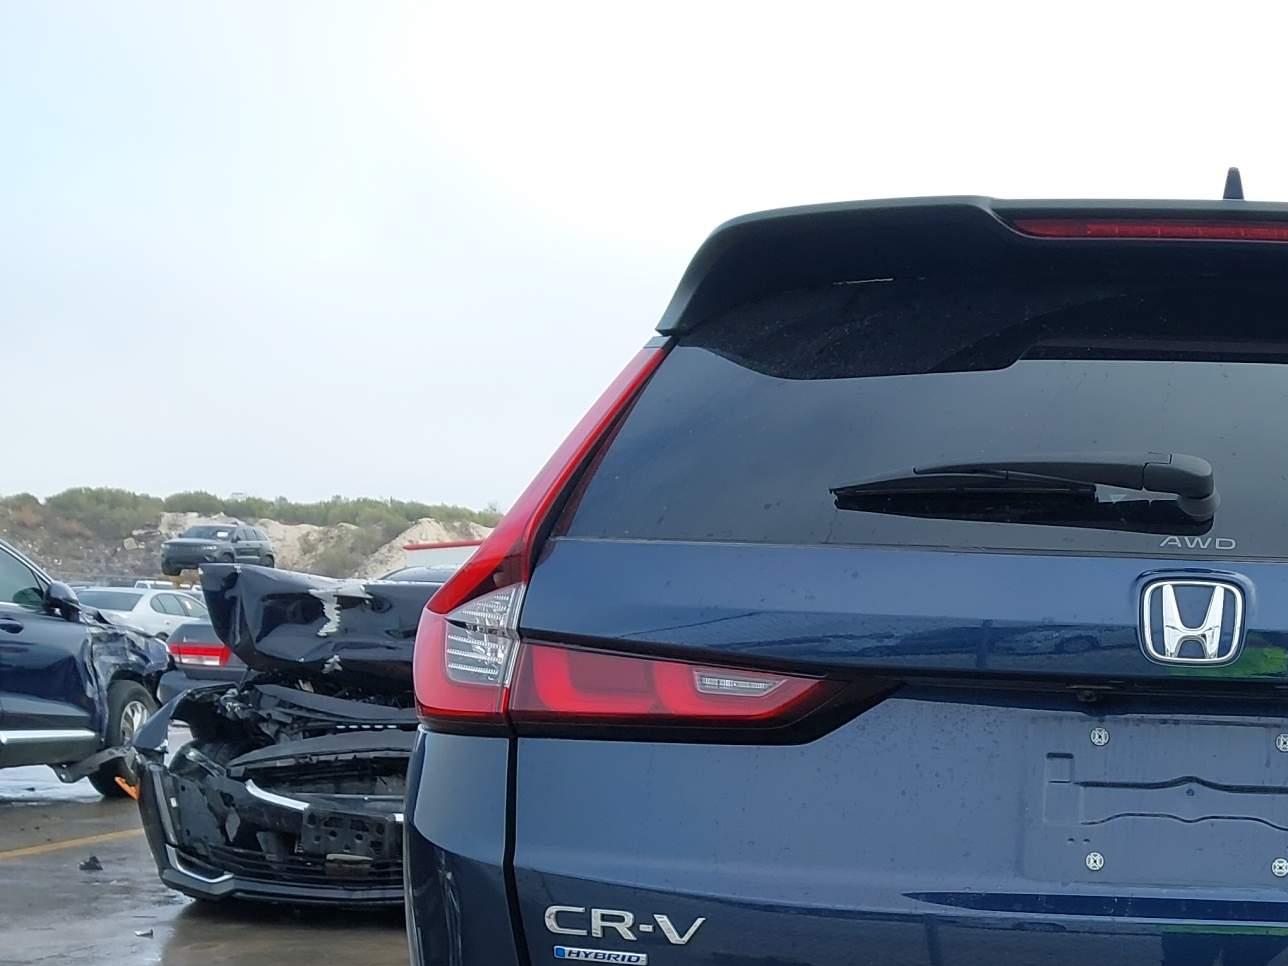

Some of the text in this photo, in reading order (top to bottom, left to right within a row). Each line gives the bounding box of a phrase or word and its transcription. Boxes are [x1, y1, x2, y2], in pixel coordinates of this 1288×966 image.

[1160, 536, 1237, 550] AWD
[545, 905, 706, 945] CR-V
[567, 949, 641, 963] HYBRID
